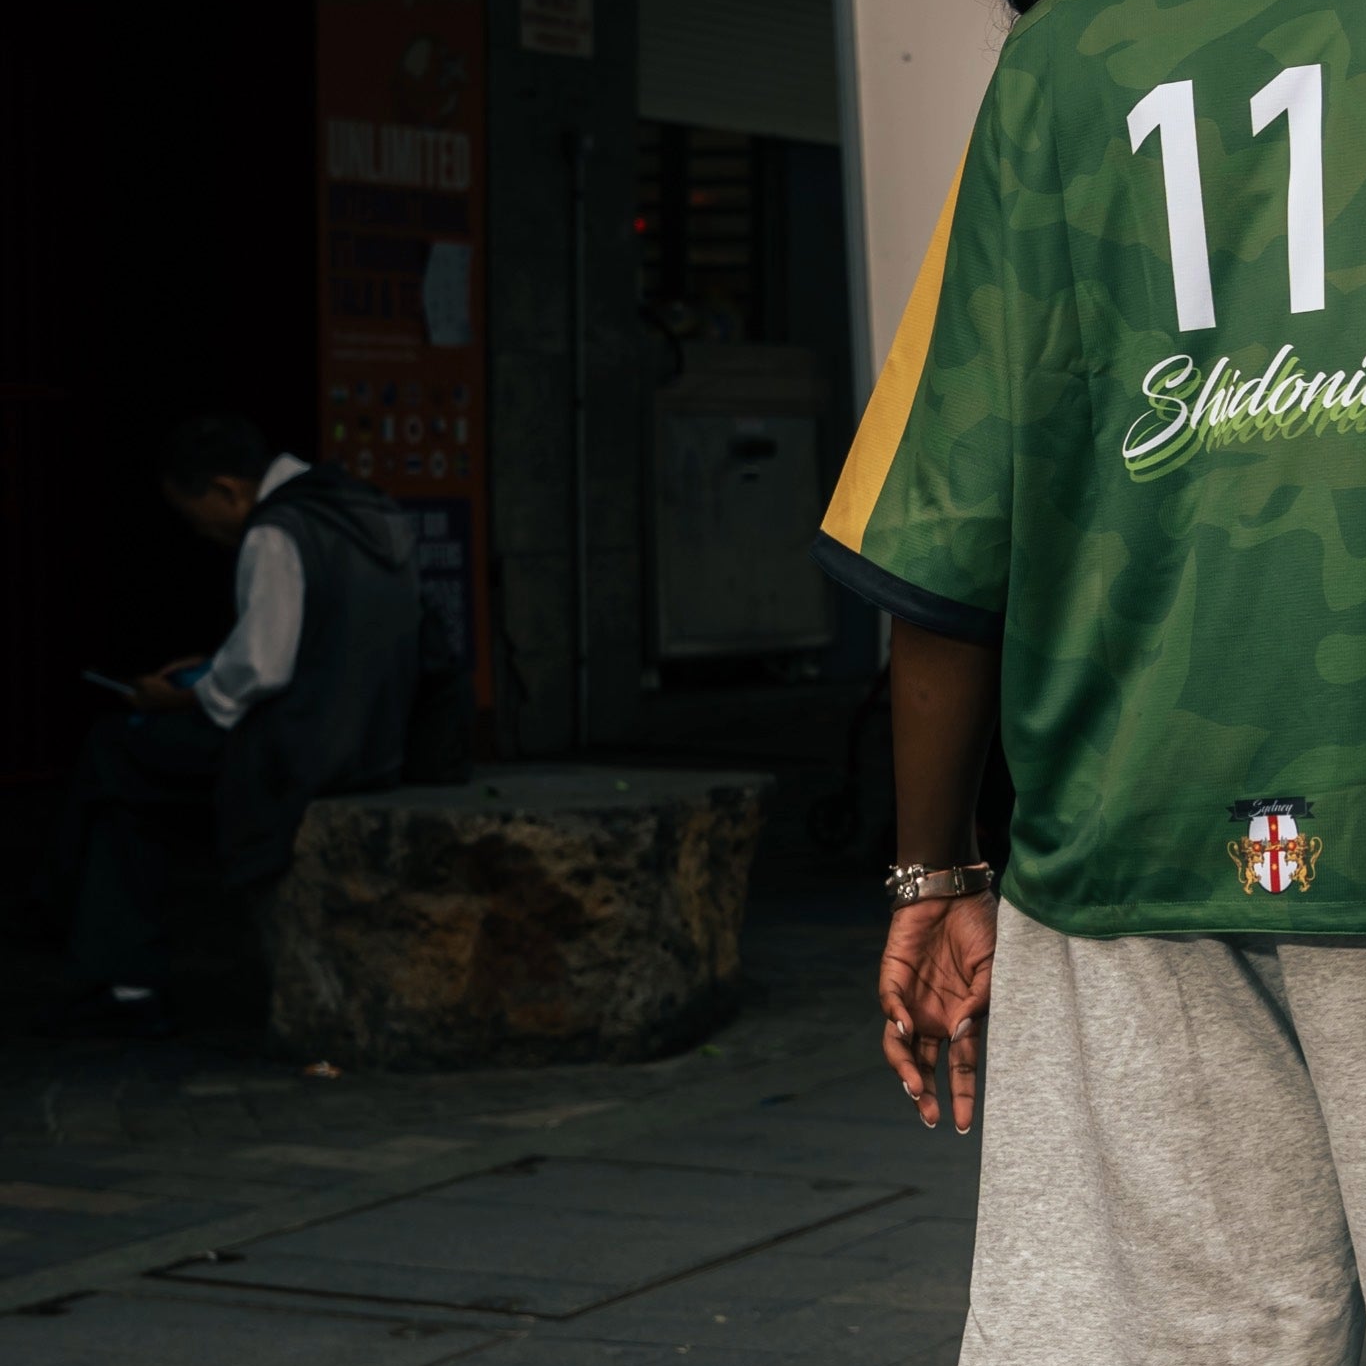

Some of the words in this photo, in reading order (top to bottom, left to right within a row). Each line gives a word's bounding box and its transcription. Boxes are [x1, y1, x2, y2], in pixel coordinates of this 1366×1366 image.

[327, 119, 470, 191] UNLIMITED
[1127, 63, 1325, 332] 11
[1248, 799, 1294, 817] Sydney
